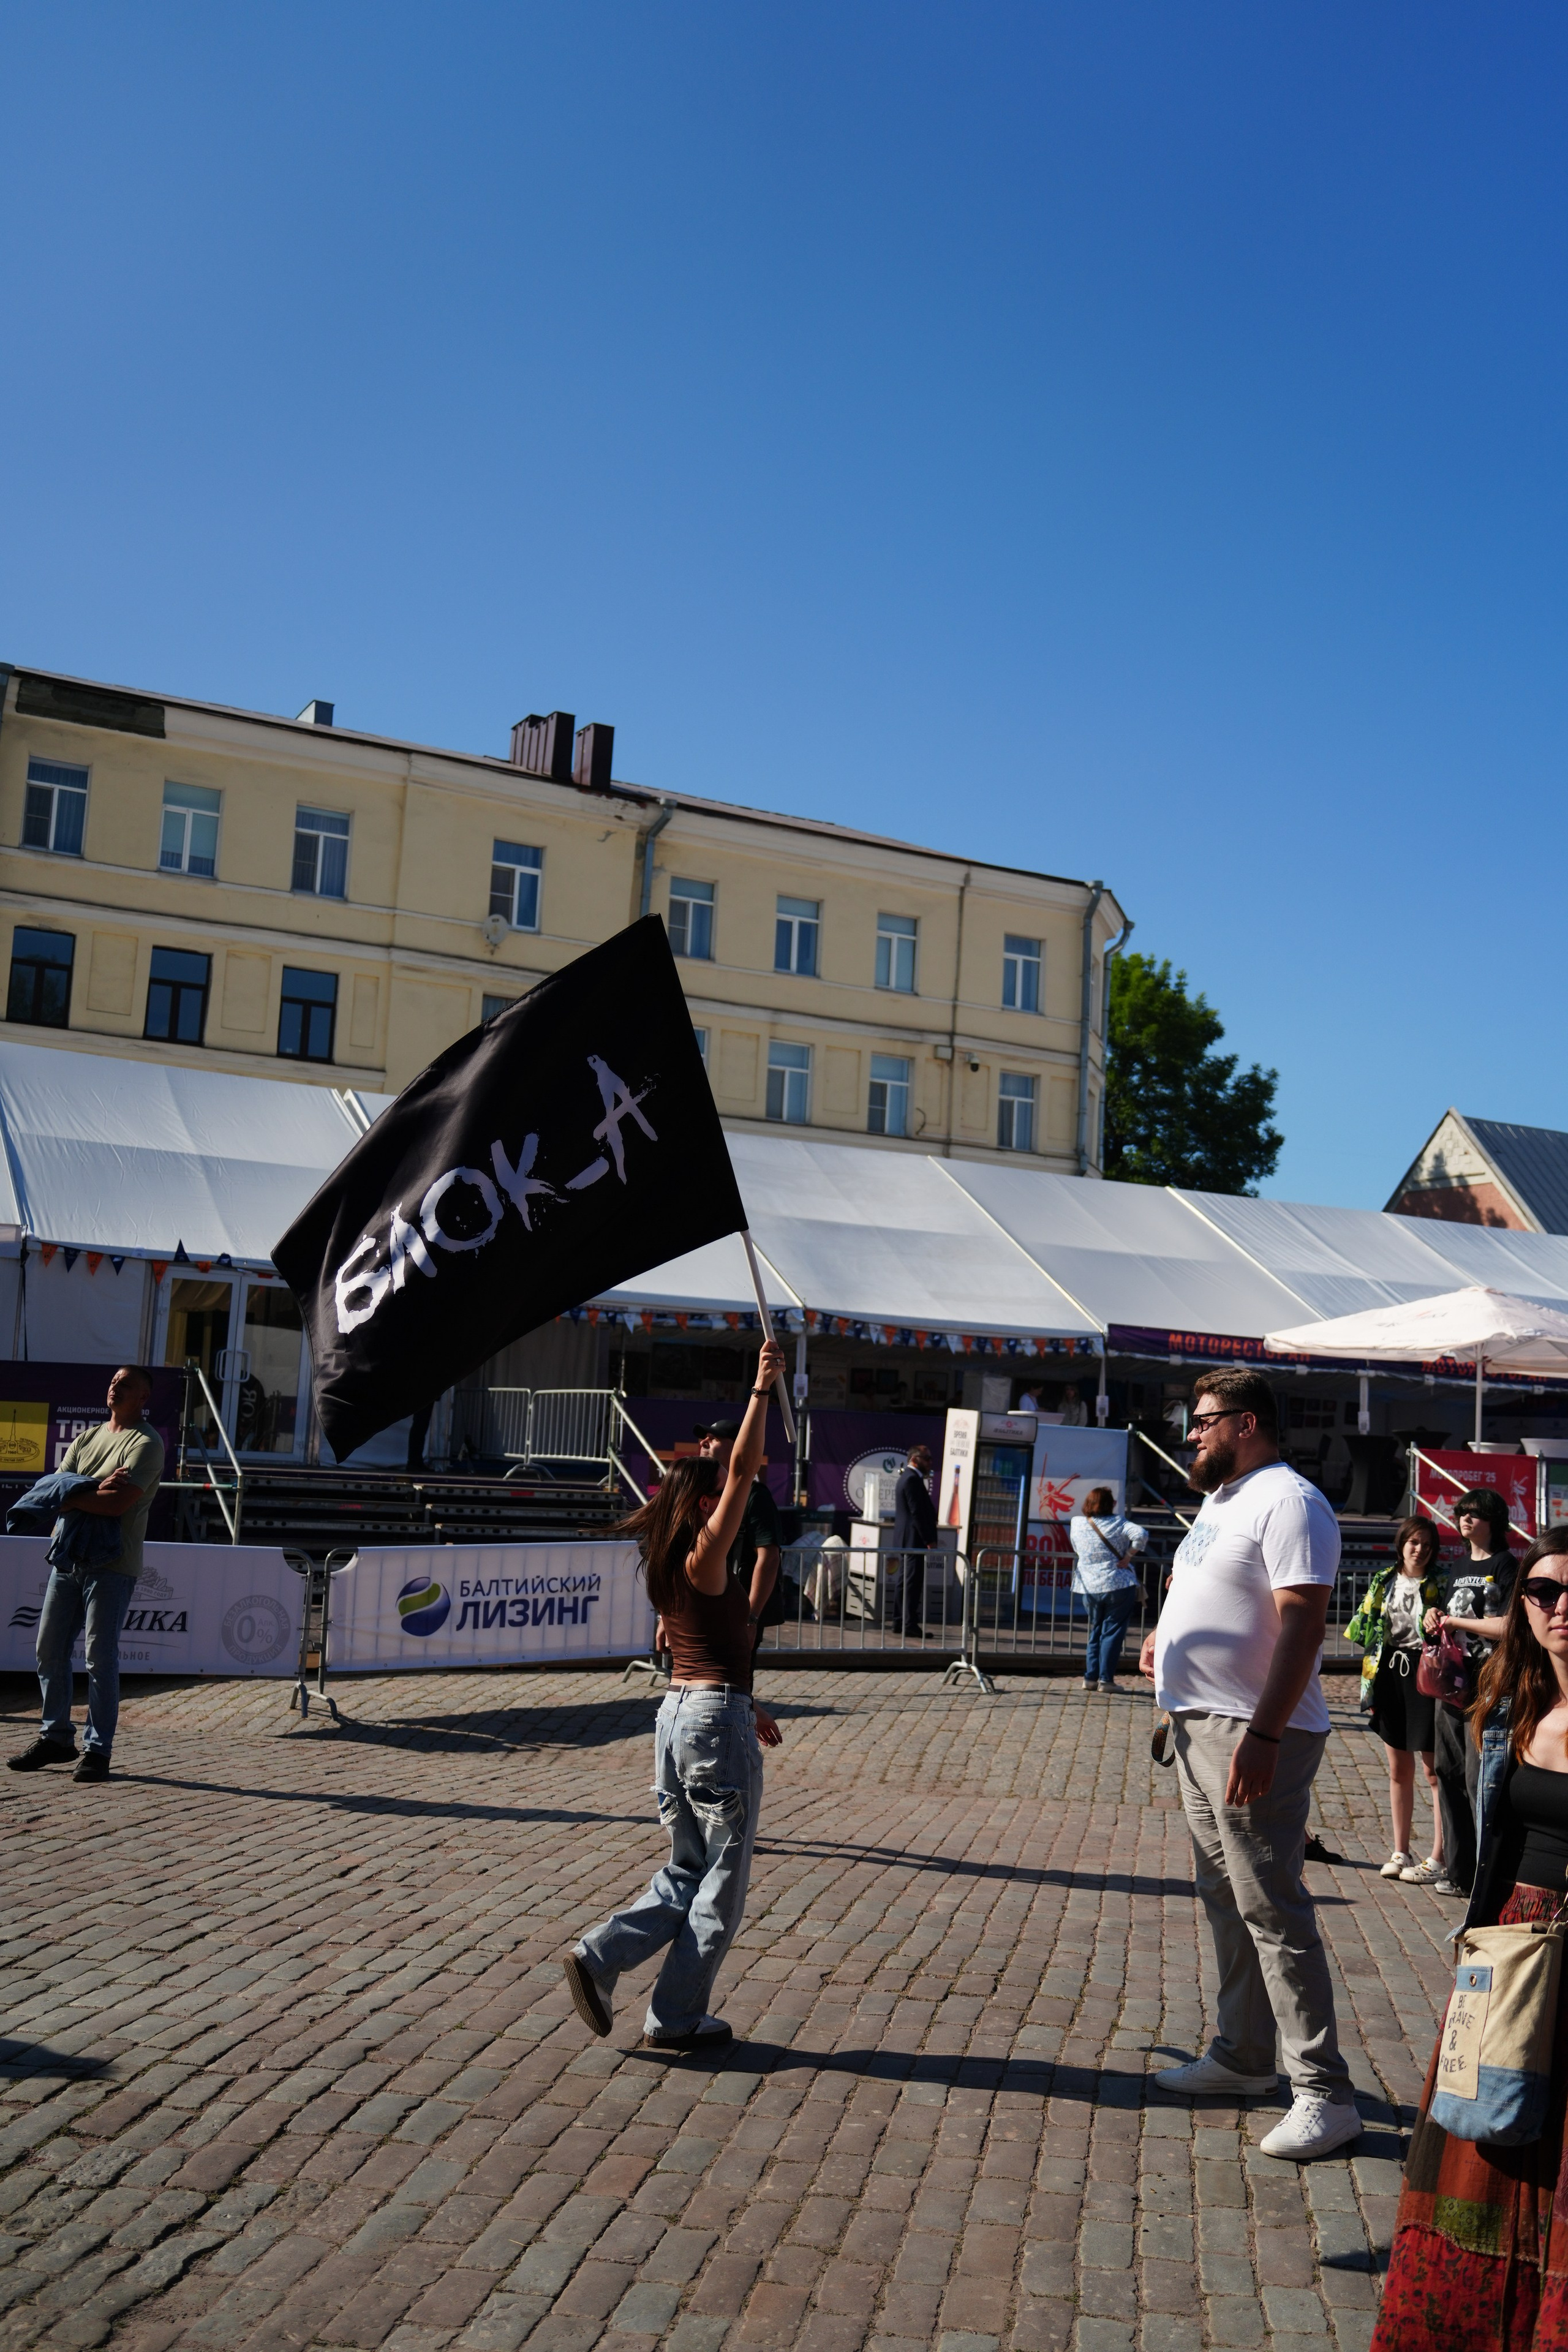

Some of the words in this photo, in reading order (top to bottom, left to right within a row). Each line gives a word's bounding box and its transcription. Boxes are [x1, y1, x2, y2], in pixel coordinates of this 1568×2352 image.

[57, 1406, 110, 1414] АКЦИОНЕРНОЕ
[460, 1573, 601, 1597] БАЛТИЙСКИЙ
[1454, 1575, 1486, 1585] ADVENTUR
[224, 1596, 289, 1629] БЕЗАЛКОГОЛЬНАЯ
[456, 1595, 599, 1632] ЛИЗИНГ
[228, 1644, 282, 1664] ПРОДУКЦИЯ
[1457, 1994, 1467, 2008] BE
[1440, 2053, 1467, 2073] FREE
